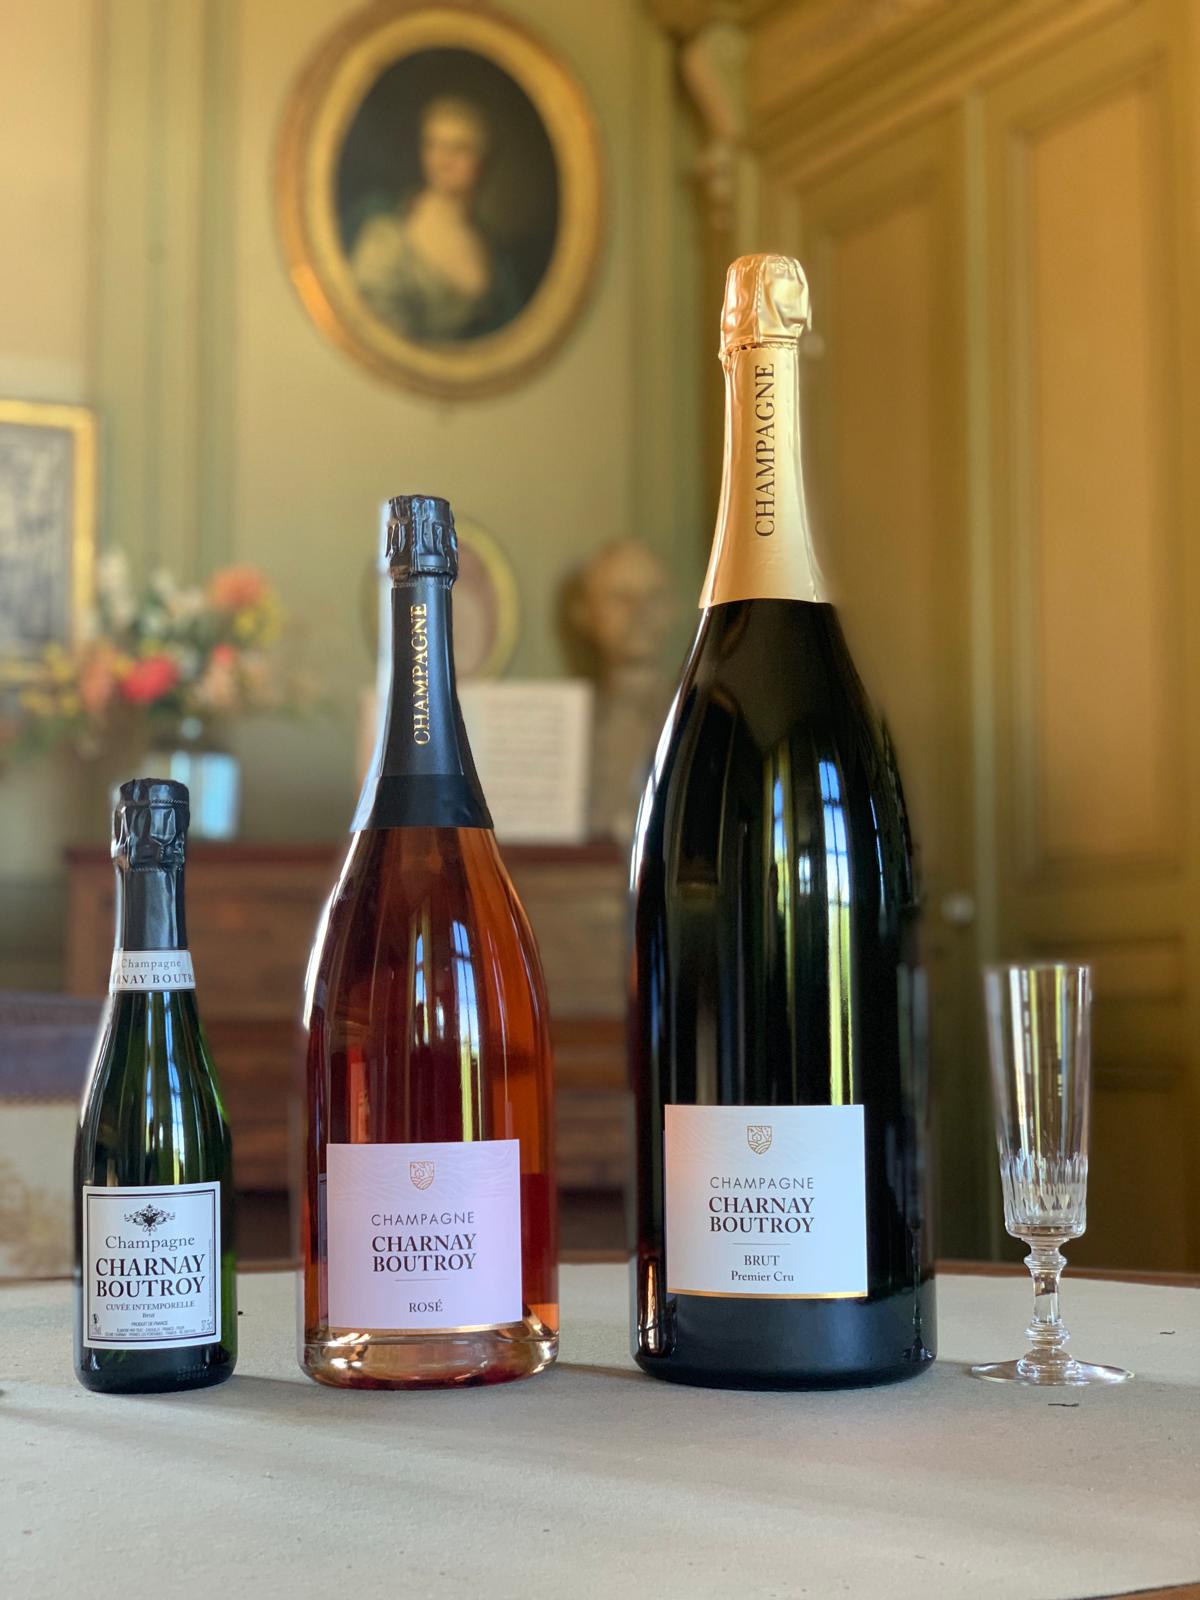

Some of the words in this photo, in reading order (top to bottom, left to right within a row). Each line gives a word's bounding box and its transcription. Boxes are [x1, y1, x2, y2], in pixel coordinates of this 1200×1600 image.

[755, 363, 776, 537] CHAMPAGNE
[410, 603, 431, 745] CHAMPAGNE
[121, 958, 182, 971] Champagne
[709, 1176, 815, 1190] CHAMPAGNE
[708, 1197, 815, 1214] CHARNAY
[371, 1210, 475, 1226] CHAMPAGNE
[709, 1216, 815, 1233] BOUTROY
[105, 1234, 195, 1252] Champagne
[371, 1233, 477, 1252] CHARNAY
[96, 1253, 206, 1277] CHARNAY
[373, 1253, 478, 1273] BOUTROY
[743, 1254, 780, 1266] BRUT
[731, 1270, 771, 1282] Premier
[773, 1271, 795, 1282] Cru
[96, 1275, 206, 1298] BOUTROY
[105, 1301, 131, 1311] CUVÉE
[132, 1300, 196, 1311] INTEMPORELLE
[408, 1299, 443, 1313] ROSÉ
